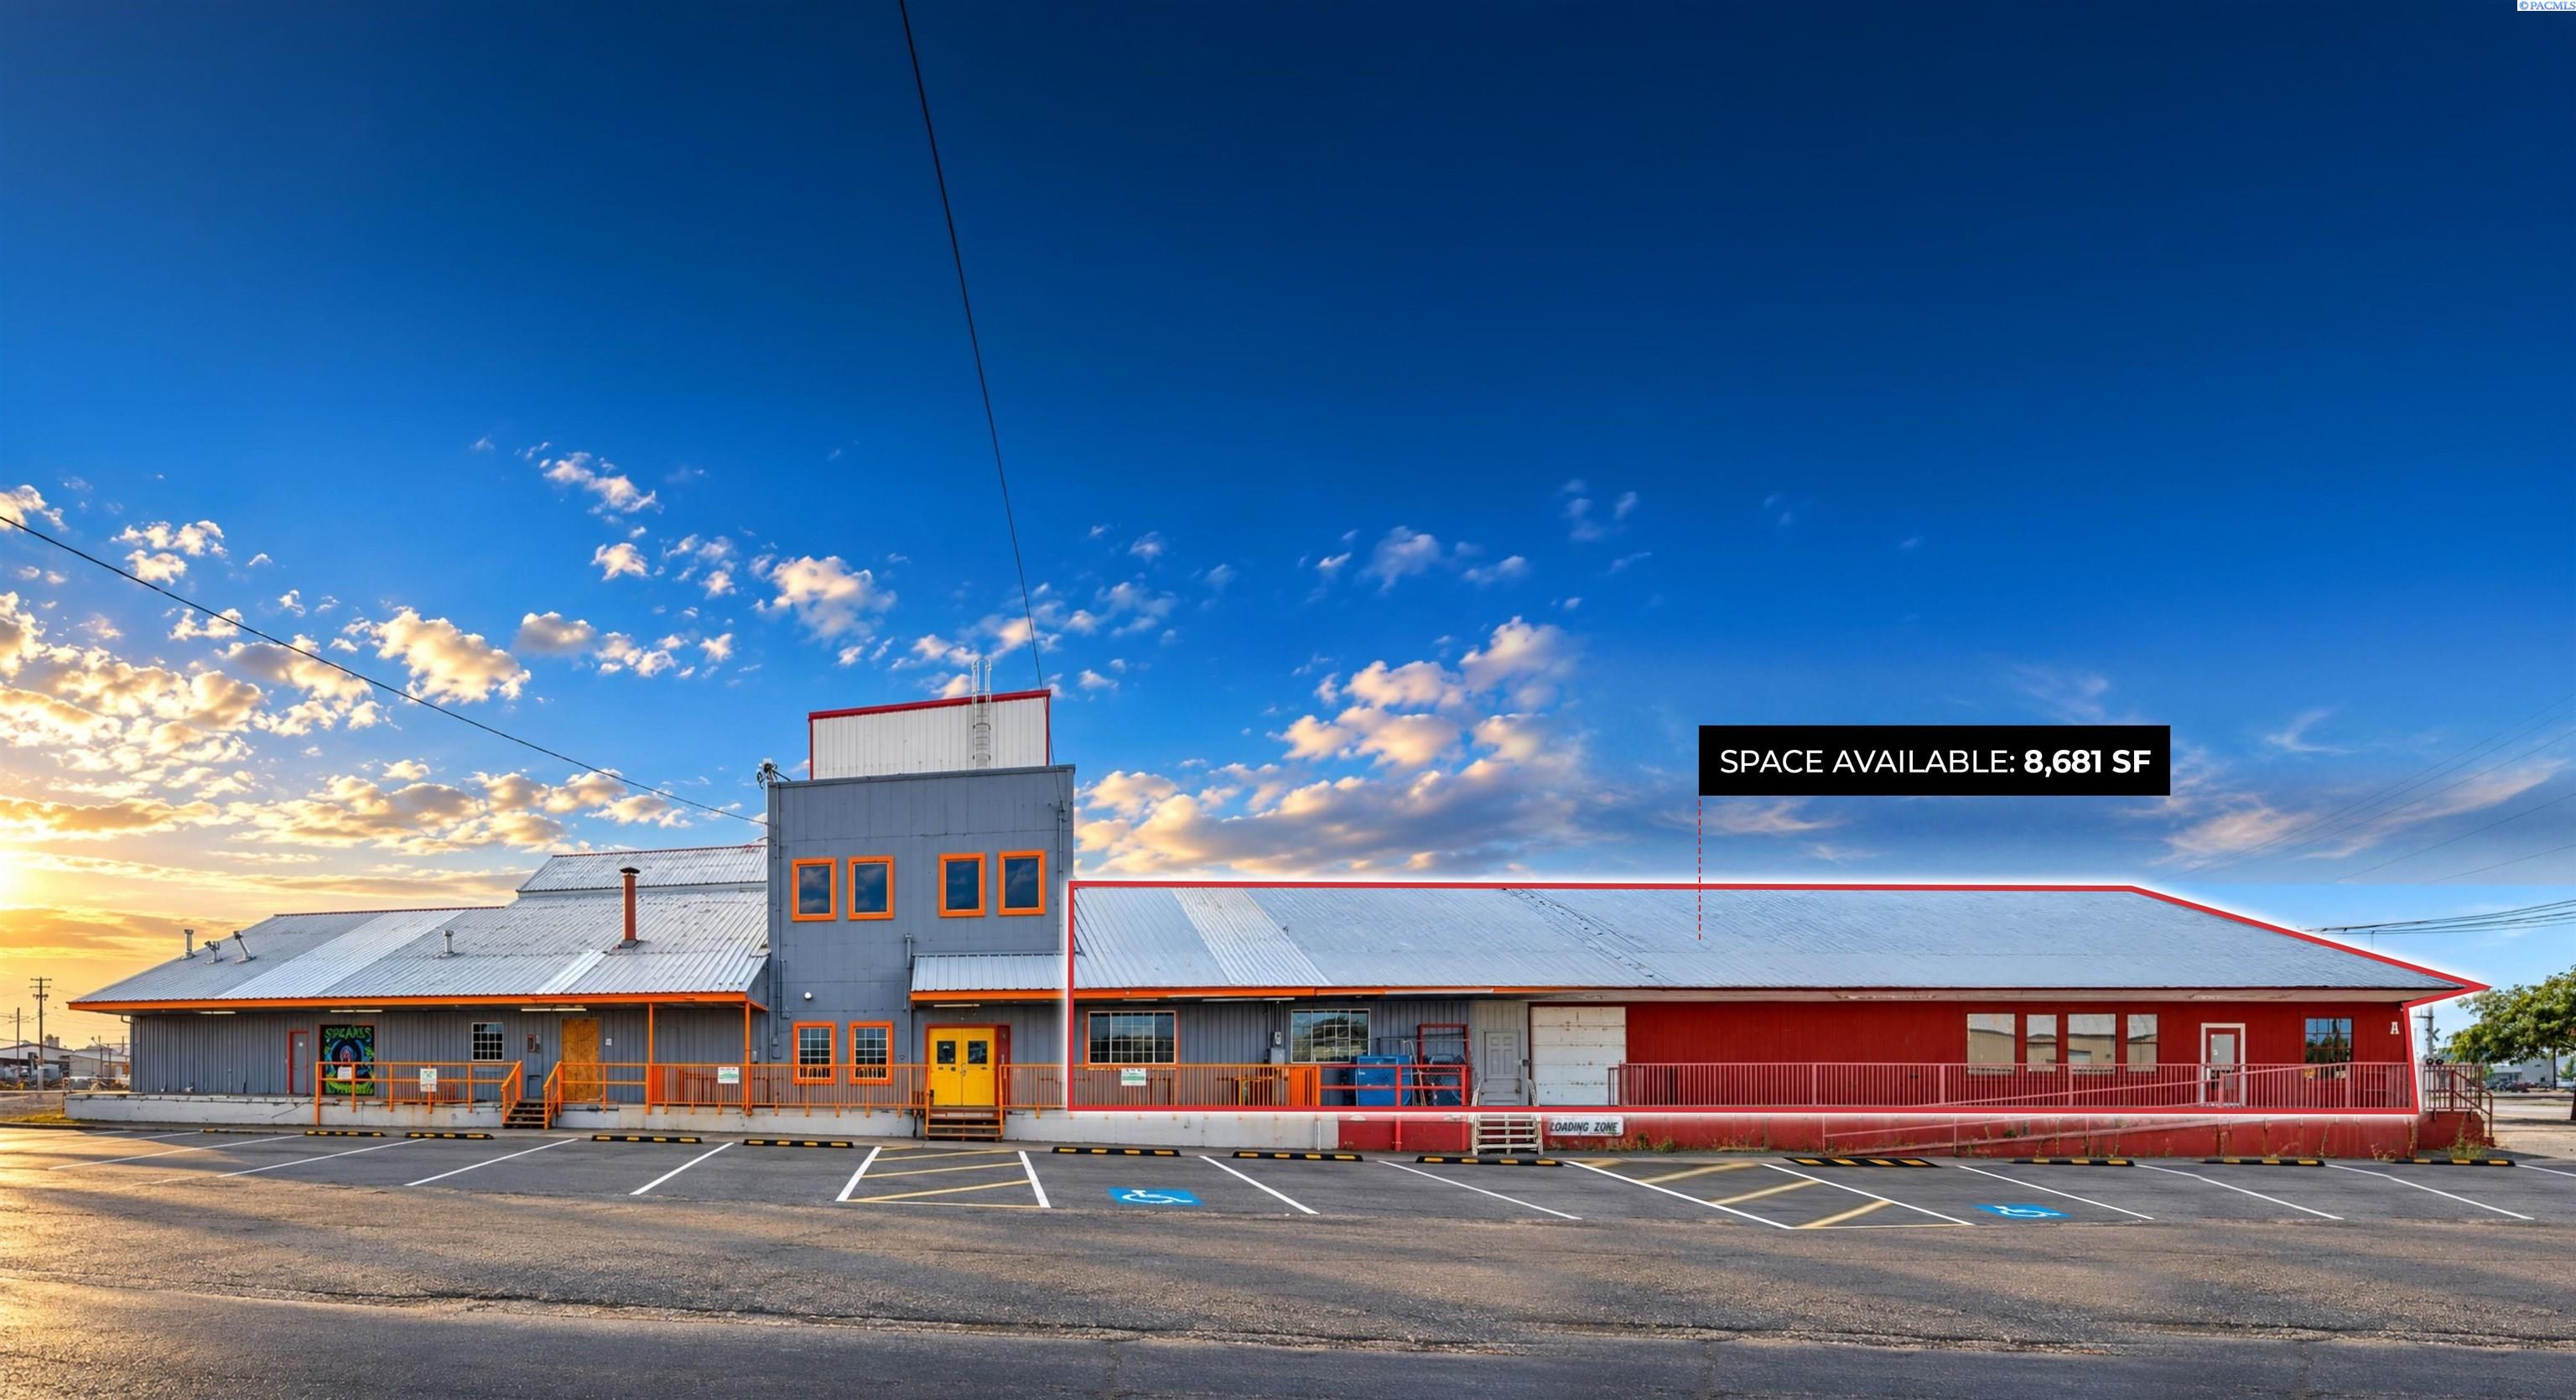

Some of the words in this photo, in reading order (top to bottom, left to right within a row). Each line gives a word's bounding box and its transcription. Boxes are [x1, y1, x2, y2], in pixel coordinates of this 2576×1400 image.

[2390, 1021, 2400, 1035] A
[1549, 1122, 1590, 1132] LOADING
[1593, 1122, 1618, 1132] ZONE
